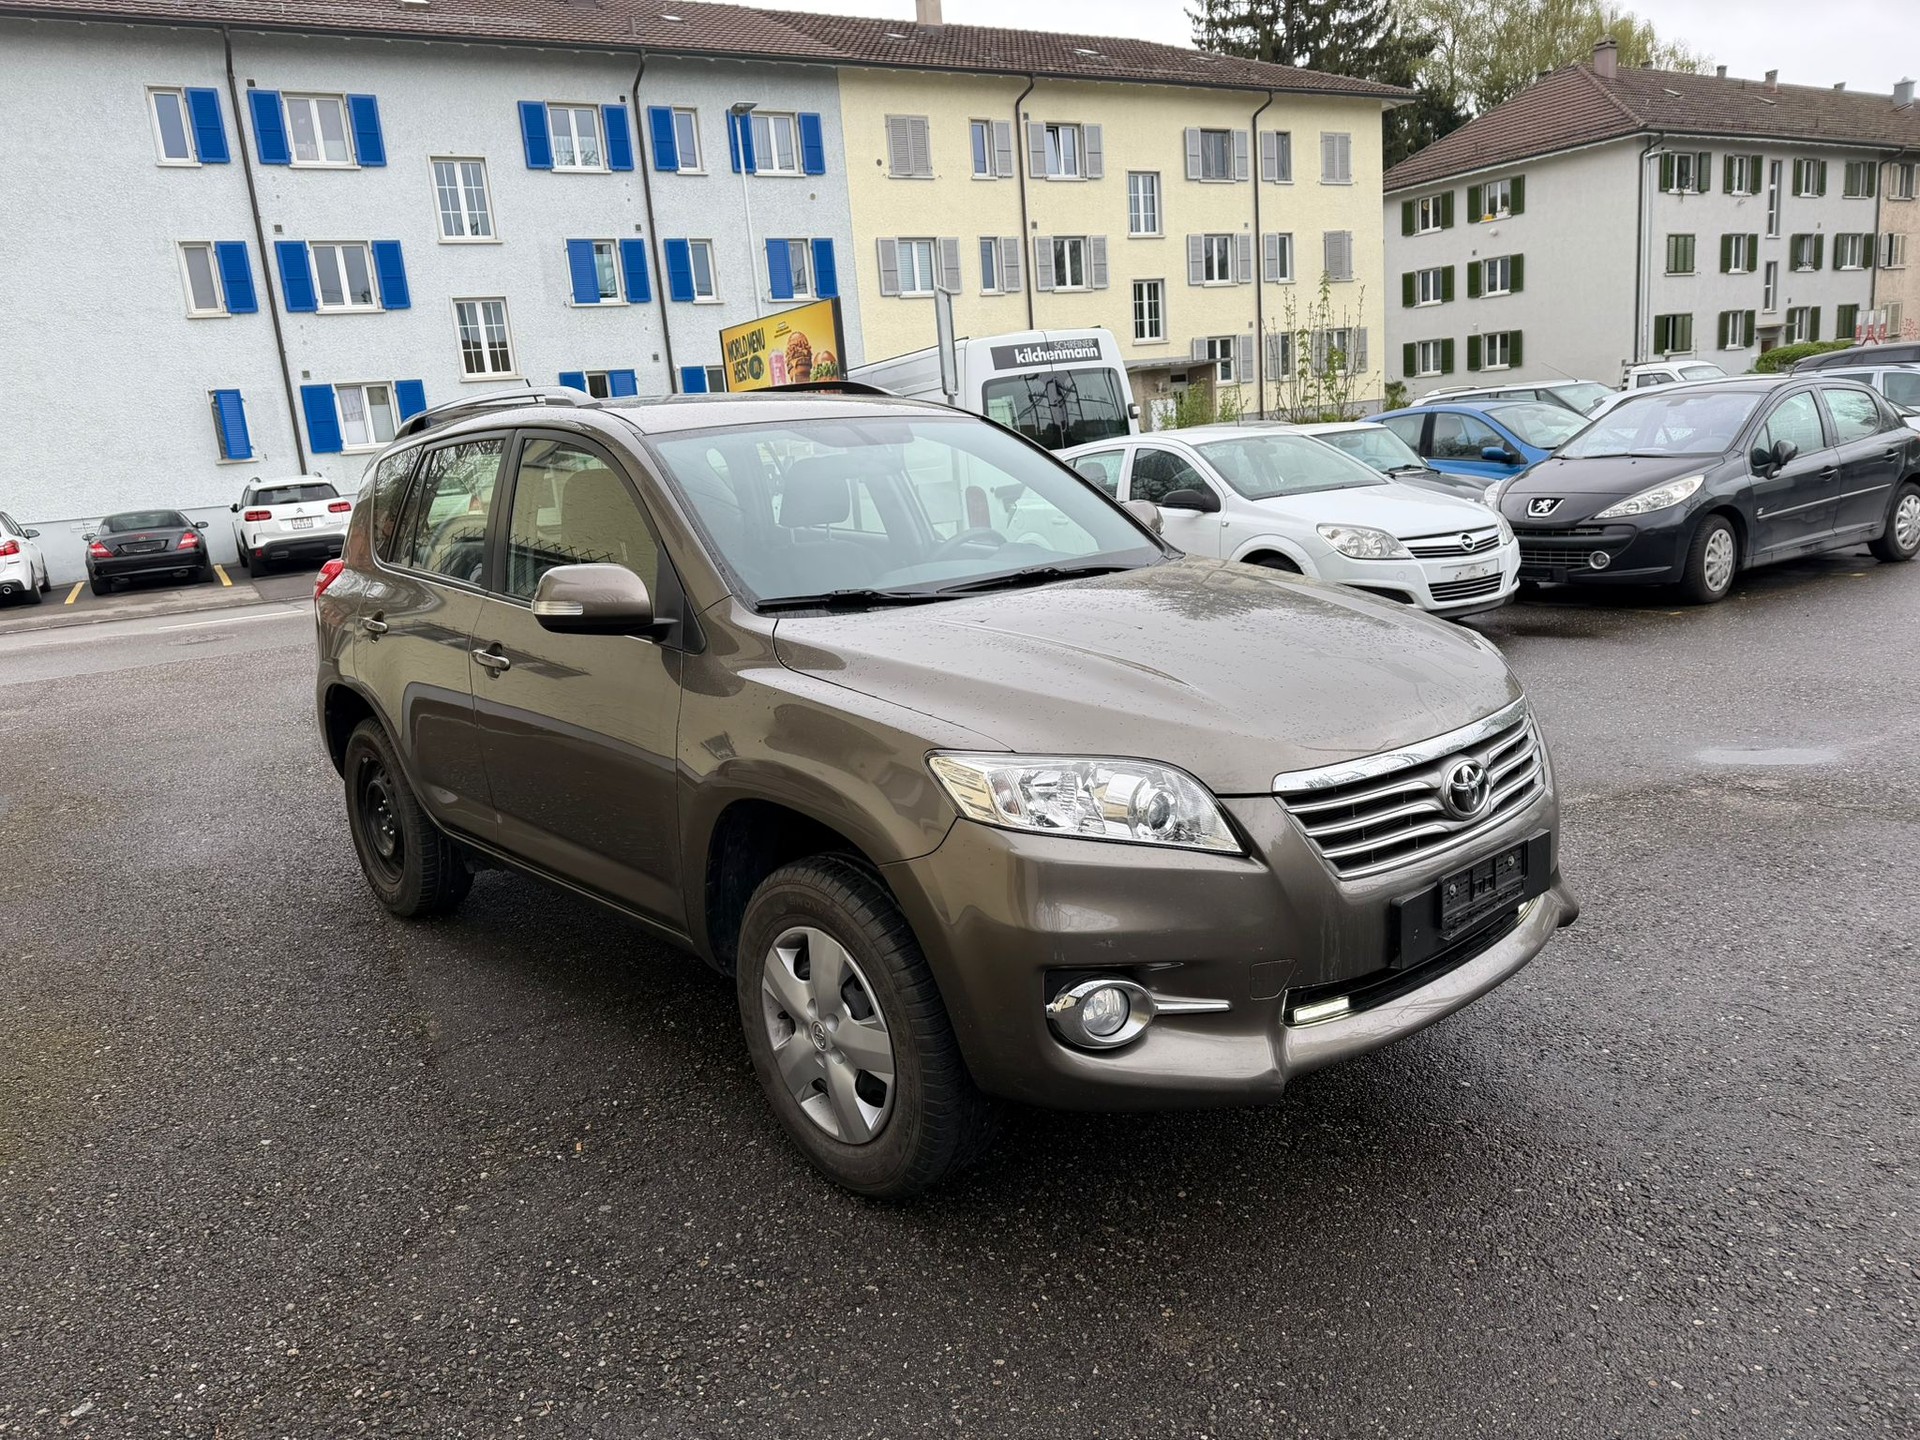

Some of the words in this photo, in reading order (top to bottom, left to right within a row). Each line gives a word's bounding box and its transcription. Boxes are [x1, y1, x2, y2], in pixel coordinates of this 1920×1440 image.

[726, 336, 748, 362] WORLD
[746, 327, 765, 355] MENU
[1054, 339, 1094, 350] SCHREINER
[1014, 347, 1099, 364] kilchenmann
